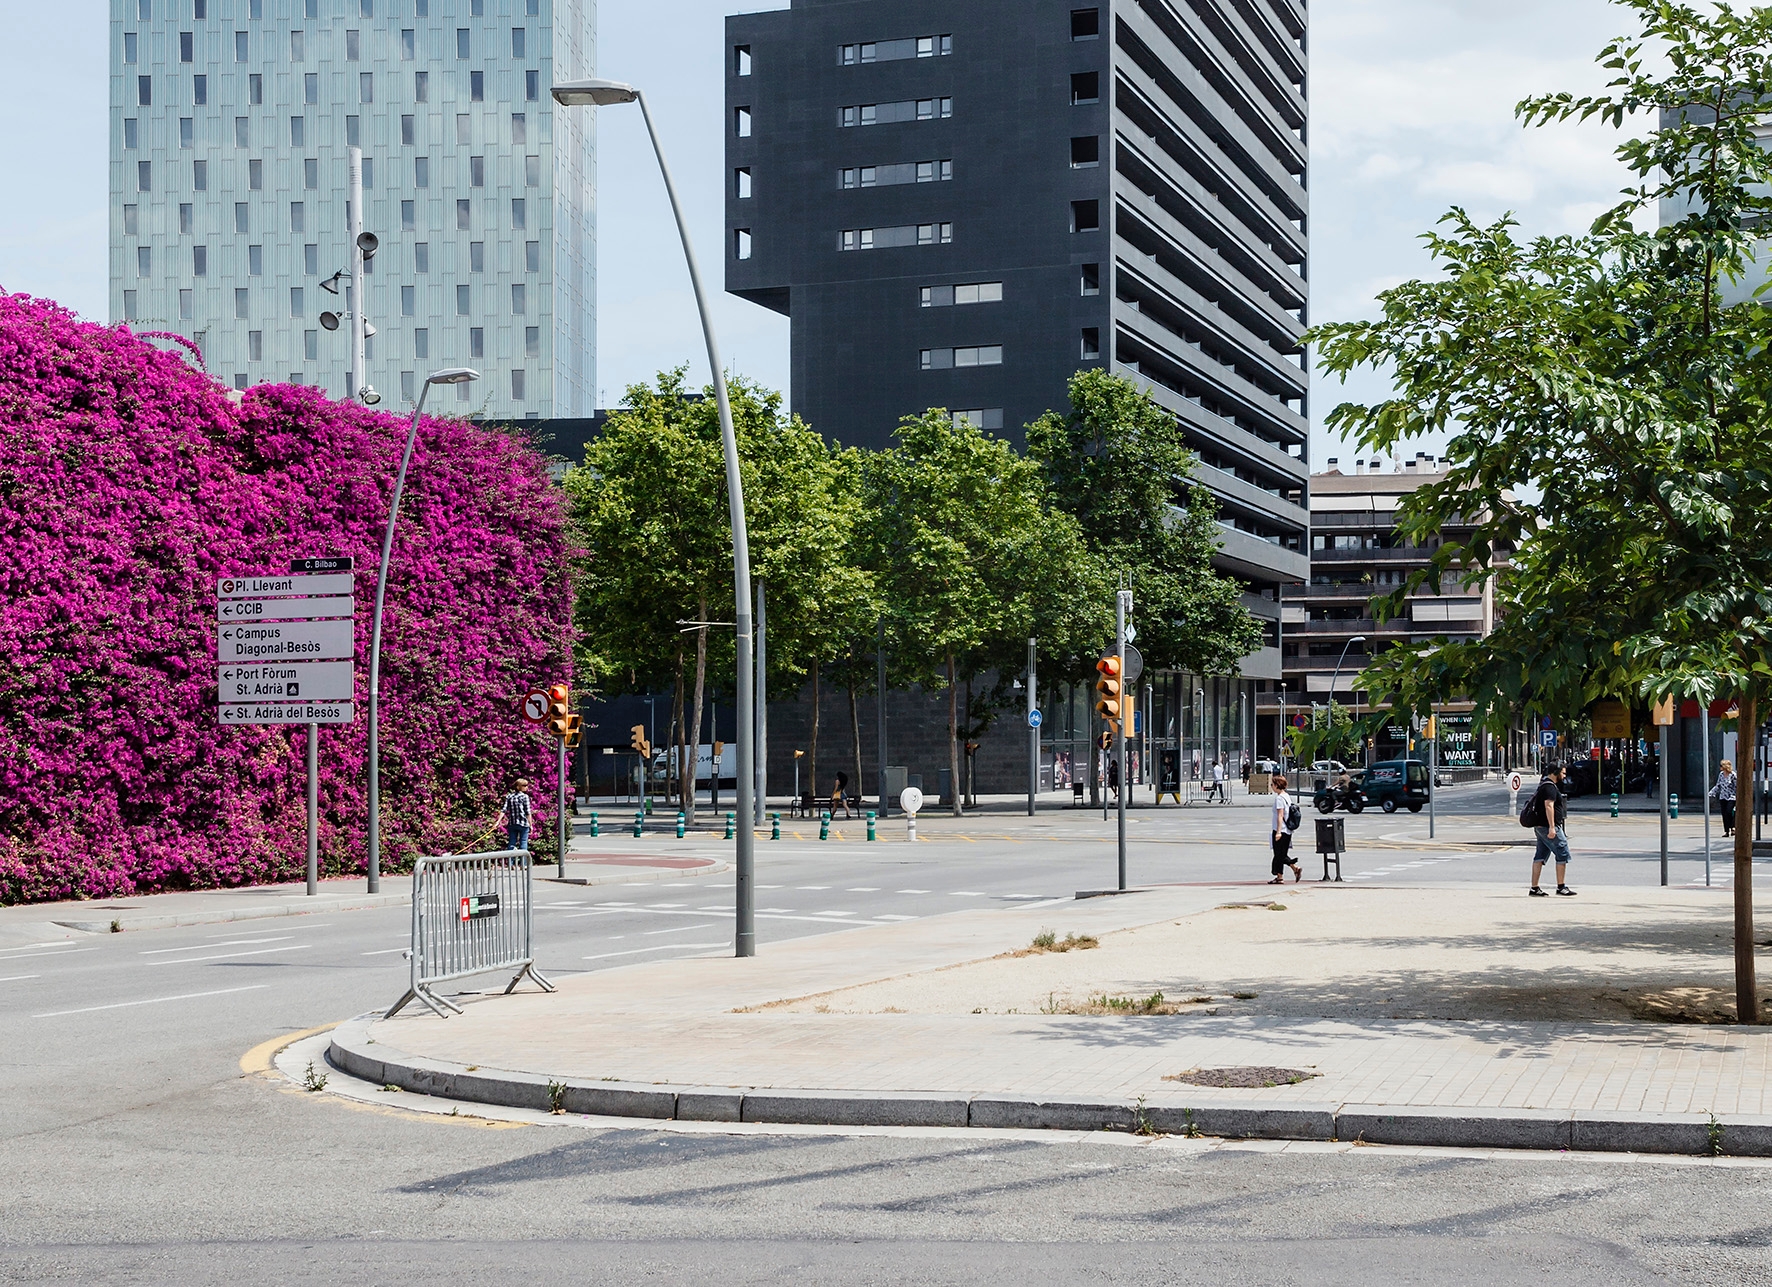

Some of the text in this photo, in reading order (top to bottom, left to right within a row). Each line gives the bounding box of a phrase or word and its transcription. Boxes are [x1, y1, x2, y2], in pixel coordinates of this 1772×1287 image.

[305, 560, 338, 568] C. Bilbao
[235, 579, 293, 592] Pl. Llevant
[236, 603, 263, 615] CCIB
[236, 627, 281, 641] Campus
[236, 640, 321, 657] Diagonal-Besòs
[236, 667, 297, 680] Port Fòrum
[236, 682, 283, 695] St. Adrià
[236, 706, 340, 719] St. Adrià del Besòs
[1543, 732, 1554, 746] P
[1456, 742, 1464, 751] U
[1444, 751, 1477, 760] WANT
